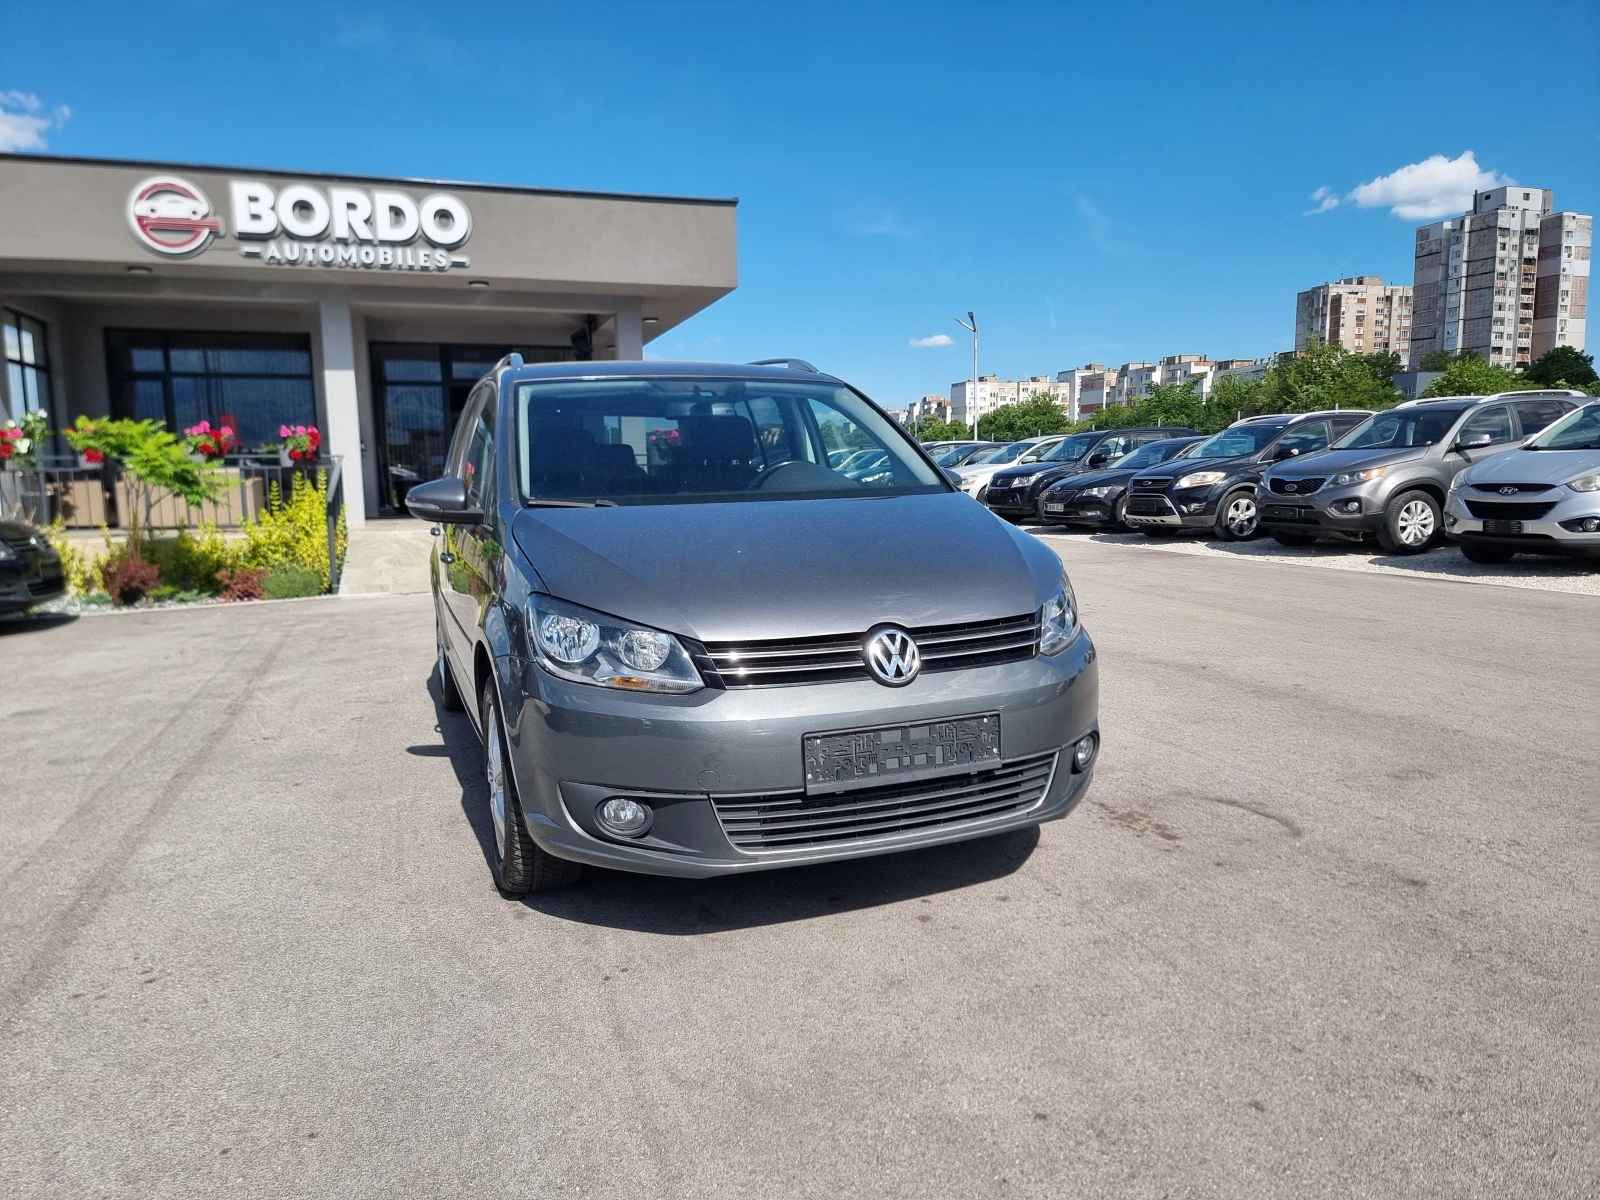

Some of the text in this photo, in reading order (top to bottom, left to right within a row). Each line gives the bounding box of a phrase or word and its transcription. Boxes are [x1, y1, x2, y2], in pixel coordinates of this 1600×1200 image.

[230, 180, 470, 248] BORDO
[264, 241, 449, 269] AUTOMOBILES
[868, 628, 921, 684] VW
